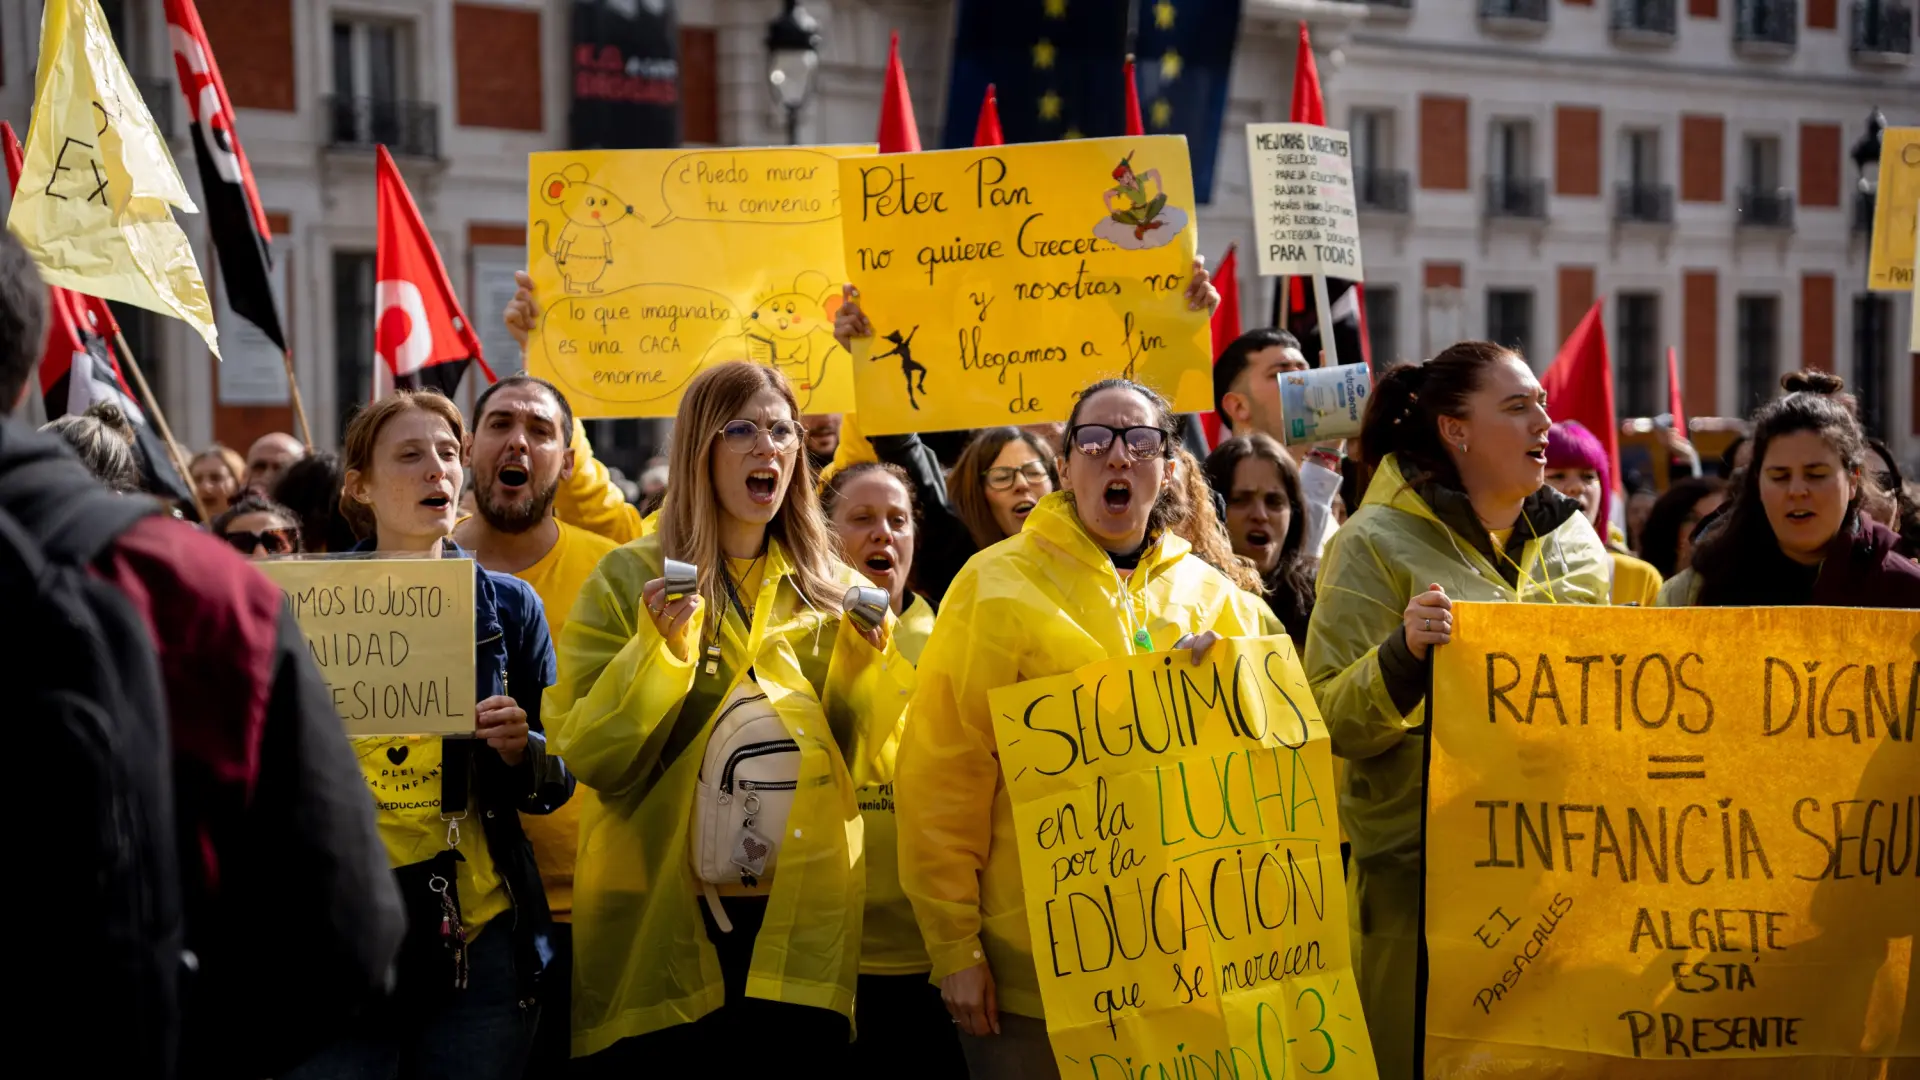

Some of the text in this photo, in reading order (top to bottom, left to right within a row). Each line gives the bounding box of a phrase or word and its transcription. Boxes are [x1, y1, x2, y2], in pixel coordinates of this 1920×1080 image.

[679, 157, 819, 184] ¿Puedo mirar
[859, 156, 1033, 222] Peter Pan
[706, 197, 727, 214] tu
[739, 190, 821, 214] convenio
[857, 244, 895, 272] no
[917, 236, 1004, 286] quiere
[1270, 244, 1355, 266] PARA TODAS
[969, 260, 1185, 322] y nosotras no
[558, 335, 682, 355] es una CACA
[569, 301, 735, 336] lo que imaginaba
[959, 311, 1168, 385] llegamos a fin
[593, 366, 667, 385] enorme
[1009, 372, 1044, 414] de
[354, 585, 375, 614] LO
[379, 575, 451, 618] JUSTO:
[1023, 650, 1310, 777] SEGUIMOS
[1485, 652, 1715, 735] RATIOS
[1036, 745, 1326, 850] en la LUCHA
[1050, 838, 1147, 895] por la
[1474, 797, 1774, 886] INFANCIA
[1045, 843, 1325, 978] EDUCACIÓN
[1628, 906, 1790, 954] ALGETE
[1473, 892, 1574, 1015] PASACALLES
[1093, 939, 1327, 1041] que se merecen
[1618, 1009, 1805, 1059] PRESENTE
